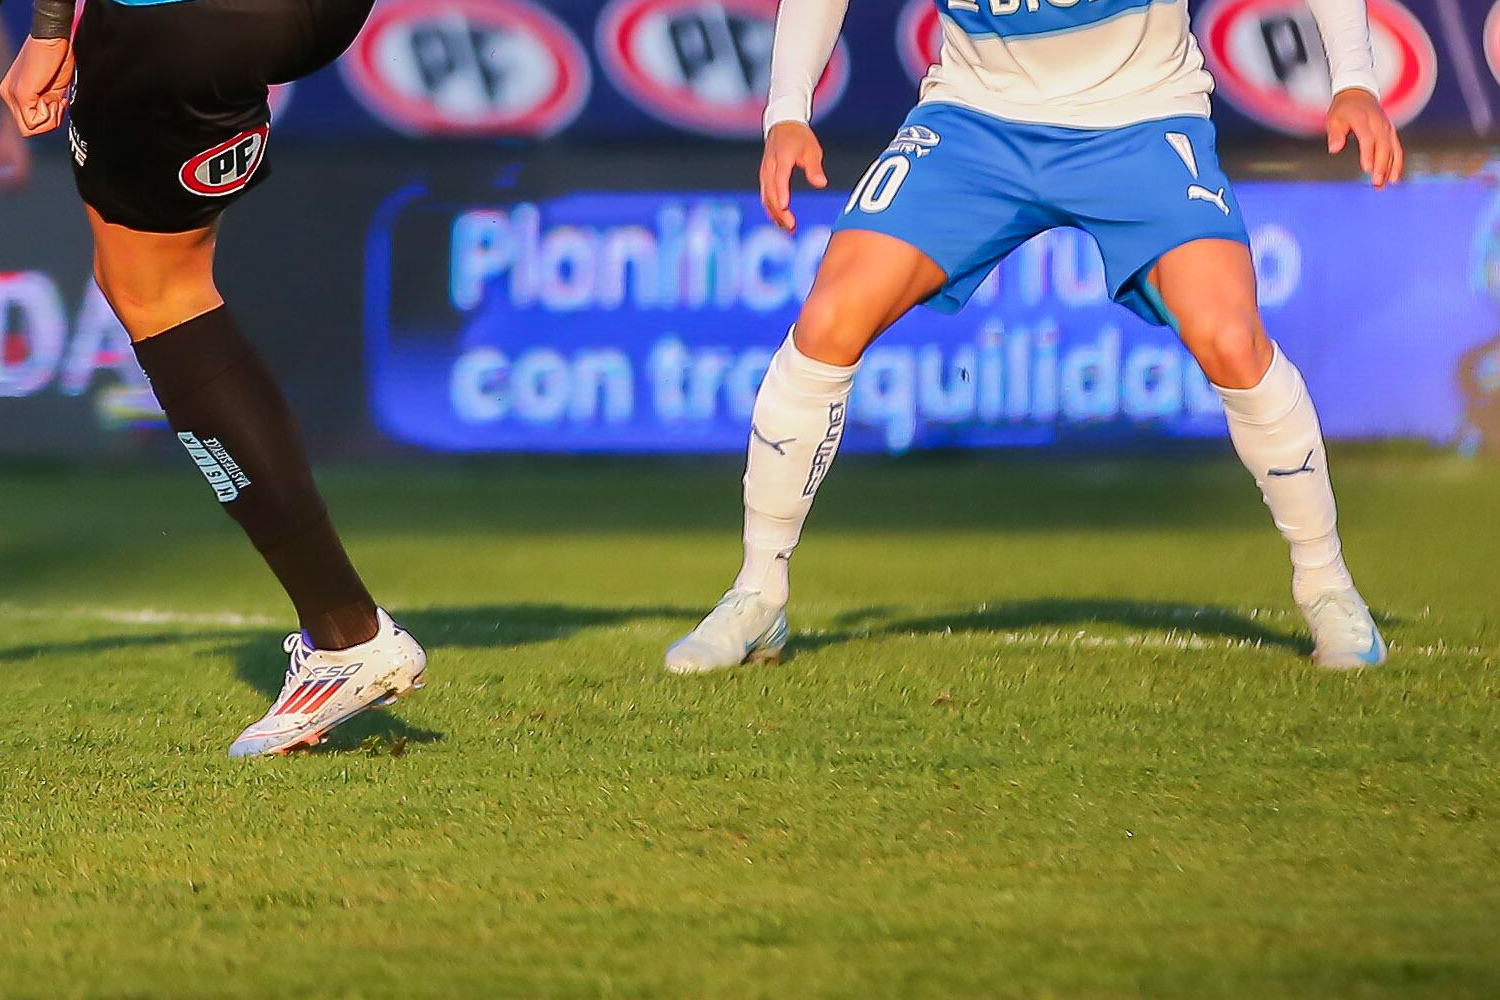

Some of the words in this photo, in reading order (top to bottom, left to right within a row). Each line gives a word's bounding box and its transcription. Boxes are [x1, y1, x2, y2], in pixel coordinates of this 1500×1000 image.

[410, 20, 510, 102] PF
[208, 135, 257, 185] PF
[449, 346, 635, 423] con
